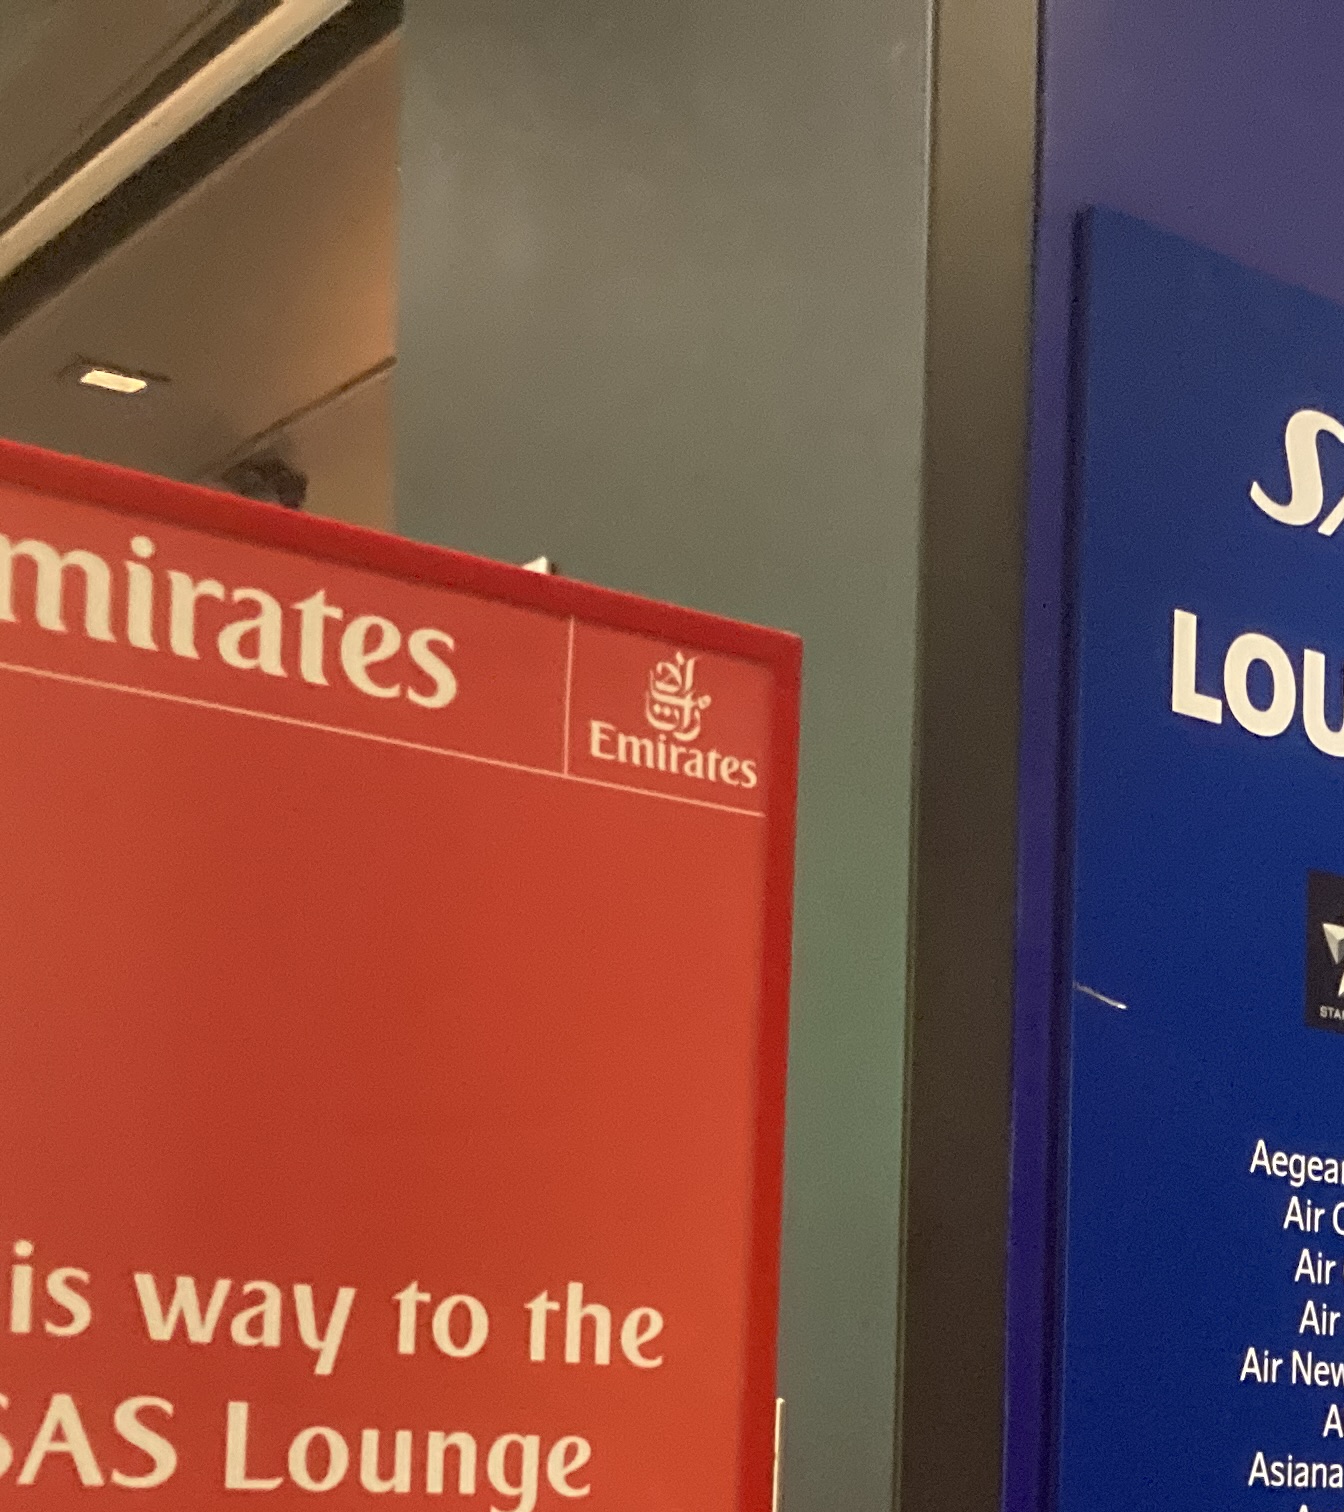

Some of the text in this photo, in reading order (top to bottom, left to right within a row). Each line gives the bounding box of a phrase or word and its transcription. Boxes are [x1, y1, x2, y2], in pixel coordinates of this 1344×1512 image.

[590, 720, 758, 788] Emirates
[1284, 1196, 1325, 1232] Air
[1295, 1248, 1336, 1286] Air
[10, 1239, 665, 1376] is way to the
[1299, 1300, 1340, 1336] Air
[1240, 1347, 1283, 1384] Air
[0, 1392, 178, 1489] AS
[1248, 1452, 1343, 1489] Asiana
